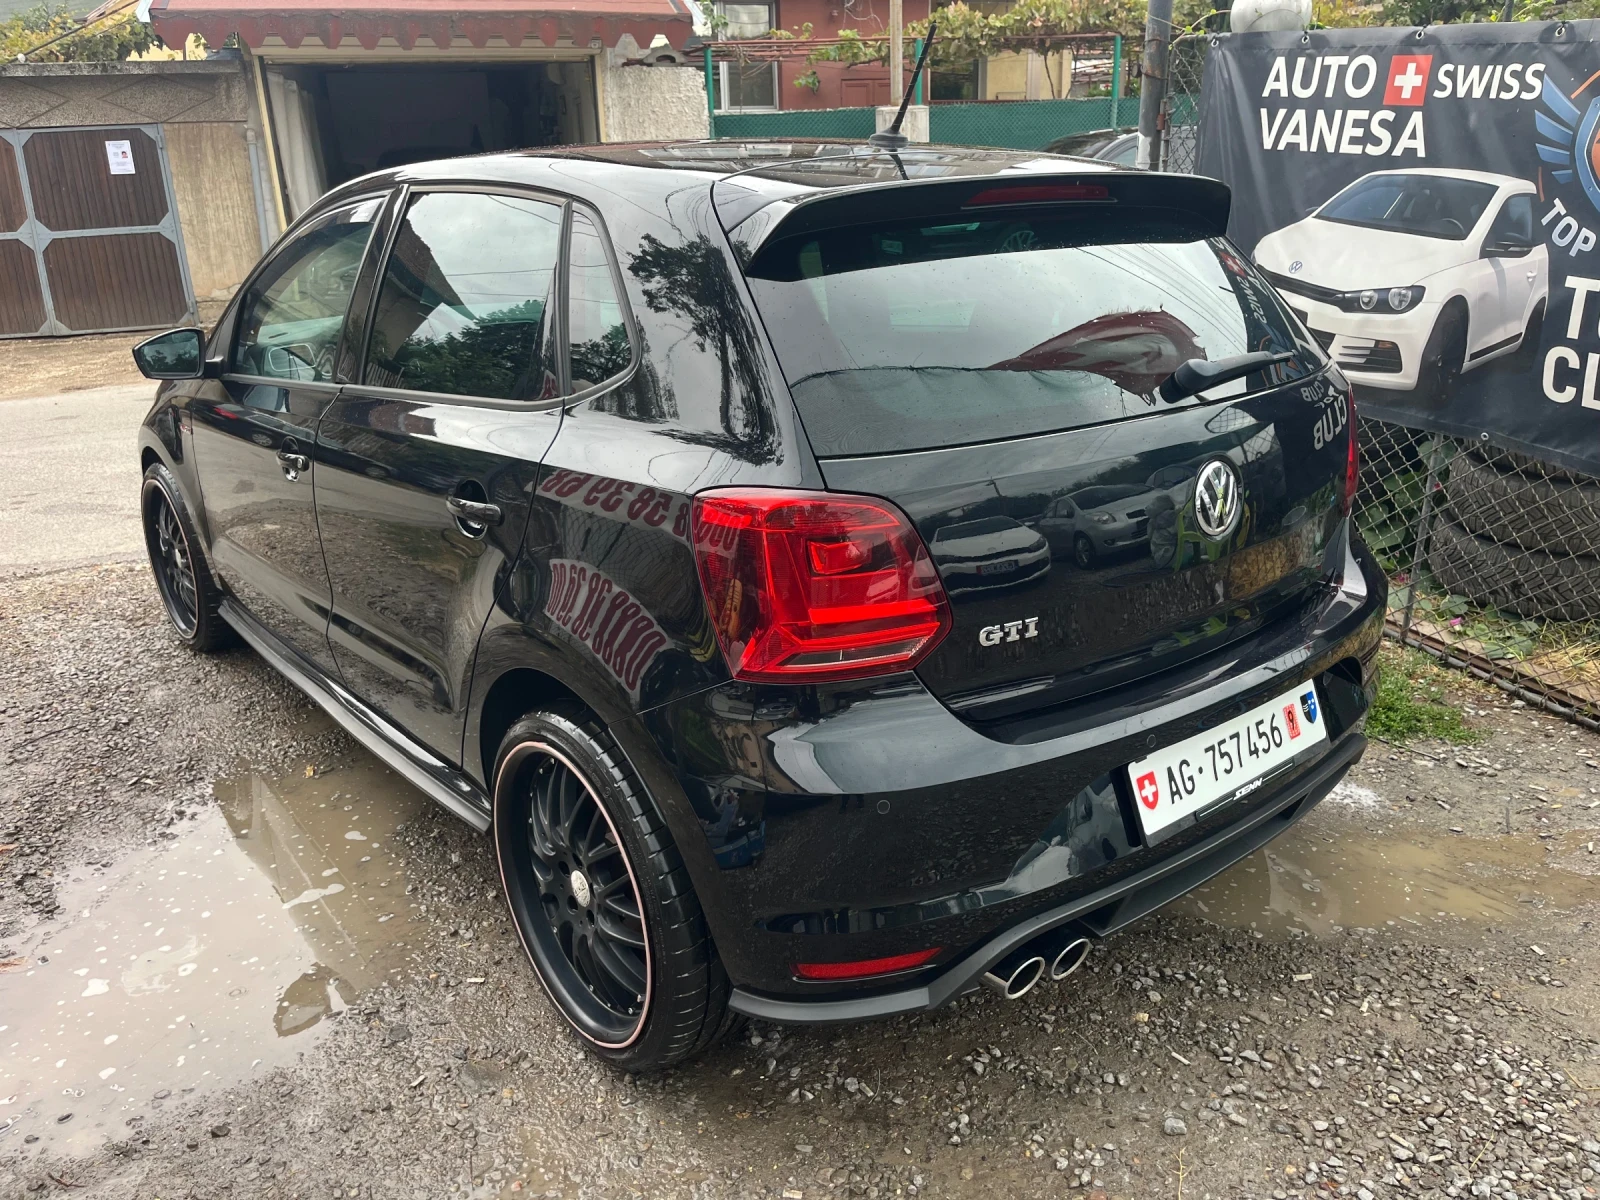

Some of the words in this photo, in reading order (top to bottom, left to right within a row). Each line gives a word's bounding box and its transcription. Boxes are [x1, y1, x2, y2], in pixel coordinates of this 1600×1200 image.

[1261, 54, 1377, 98] AUTO
[1432, 62, 1546, 100] SWISS
[1259, 108, 1426, 158] VANESA
[1540, 198, 1597, 257] TOP
[1564, 275, 1600, 340] T
[979, 616, 1039, 647] GTI
